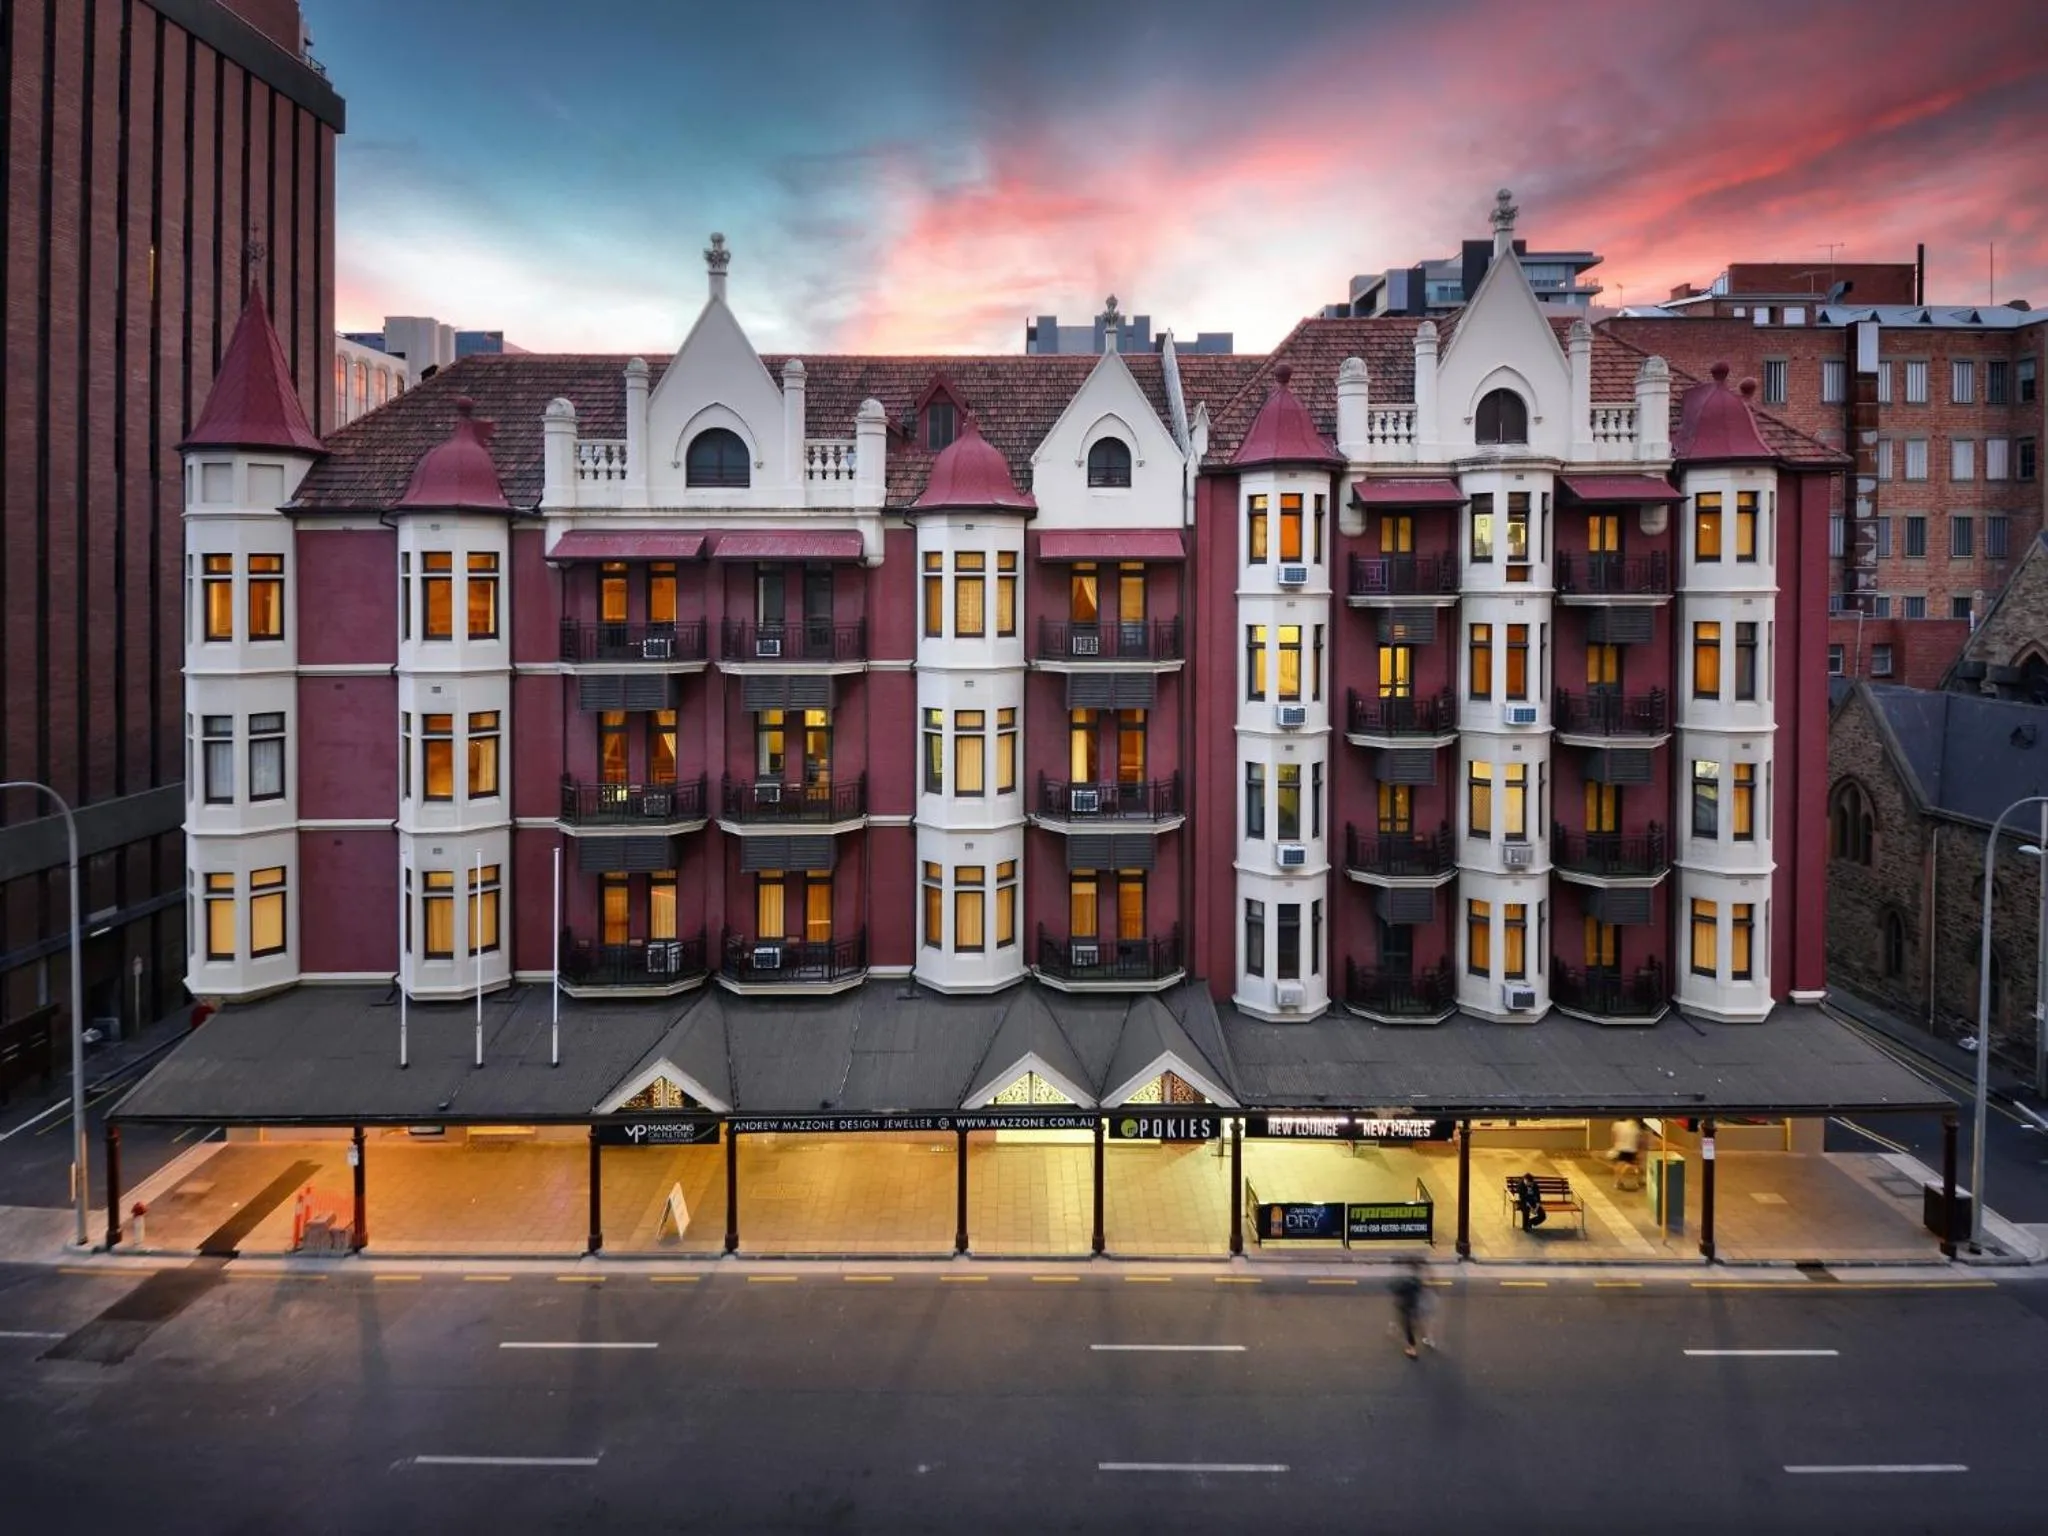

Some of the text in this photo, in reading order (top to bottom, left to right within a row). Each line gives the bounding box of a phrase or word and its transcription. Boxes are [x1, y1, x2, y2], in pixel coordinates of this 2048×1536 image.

[734, 1121, 778, 1130] ANDREW
[783, 1121, 834, 1130] MAZZONE
[840, 1120, 879, 1129] DESIGN
[884, 1119, 932, 1129] JEWELLER
[956, 1117, 1095, 1128] WWW.MAZZONE.COM.AU
[1140, 1119, 1210, 1138] POKIES
[1267, 1119, 1339, 1136] NEW LOUNGE
[1363, 1120, 1431, 1137] NEW POKIES
